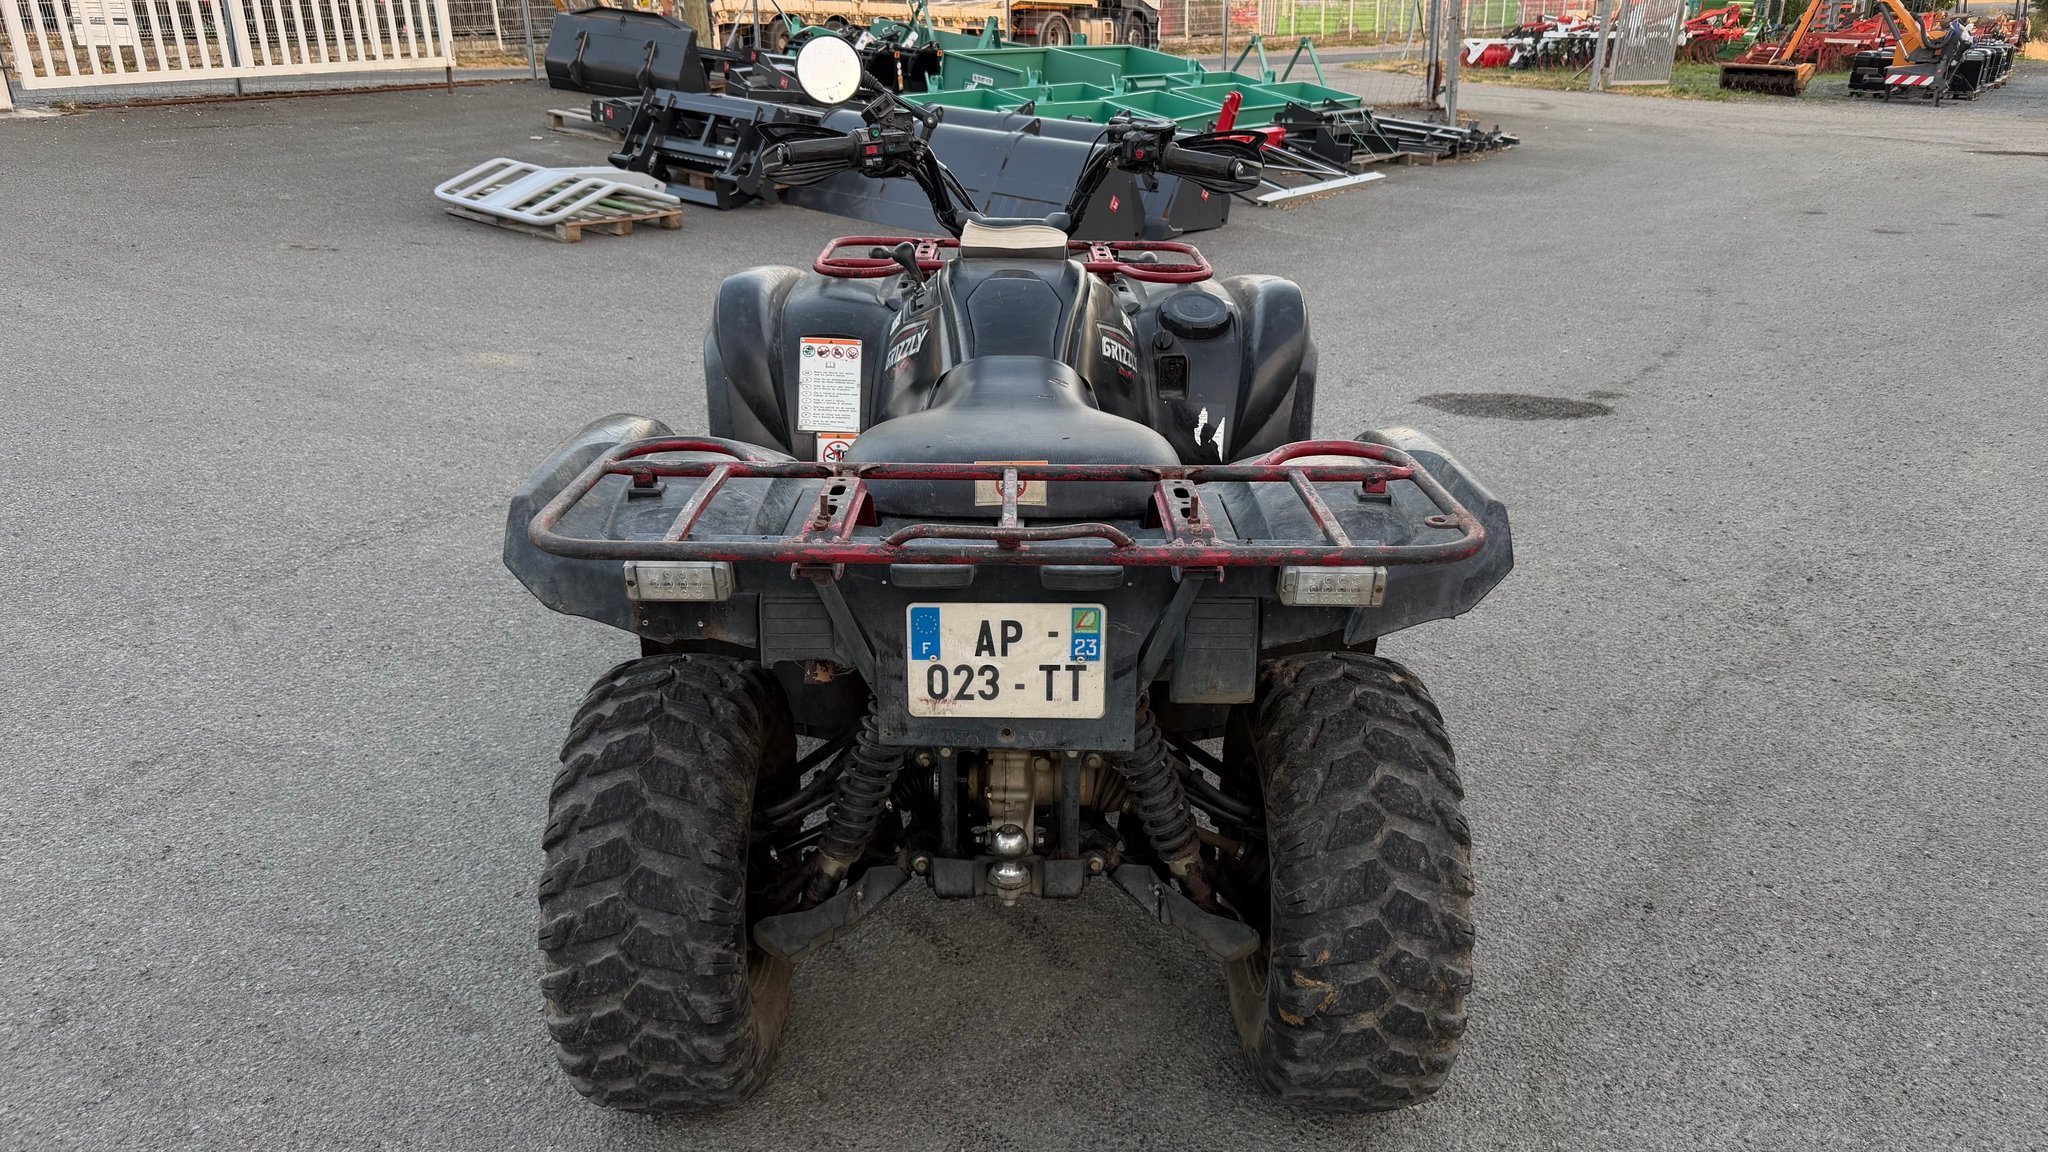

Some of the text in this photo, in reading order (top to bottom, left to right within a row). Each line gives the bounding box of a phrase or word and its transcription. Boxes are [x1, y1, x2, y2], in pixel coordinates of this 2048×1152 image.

[885, 325, 929, 371] GRIZZLY
[1101, 335, 1138, 373] GRIZZLY
[922, 642, 931, 654] F
[974, 620, 1023, 657] AP
[1075, 638, 1097, 656] 23
[927, 664, 1000, 700] 023
[1039, 665, 1087, 701] TT
